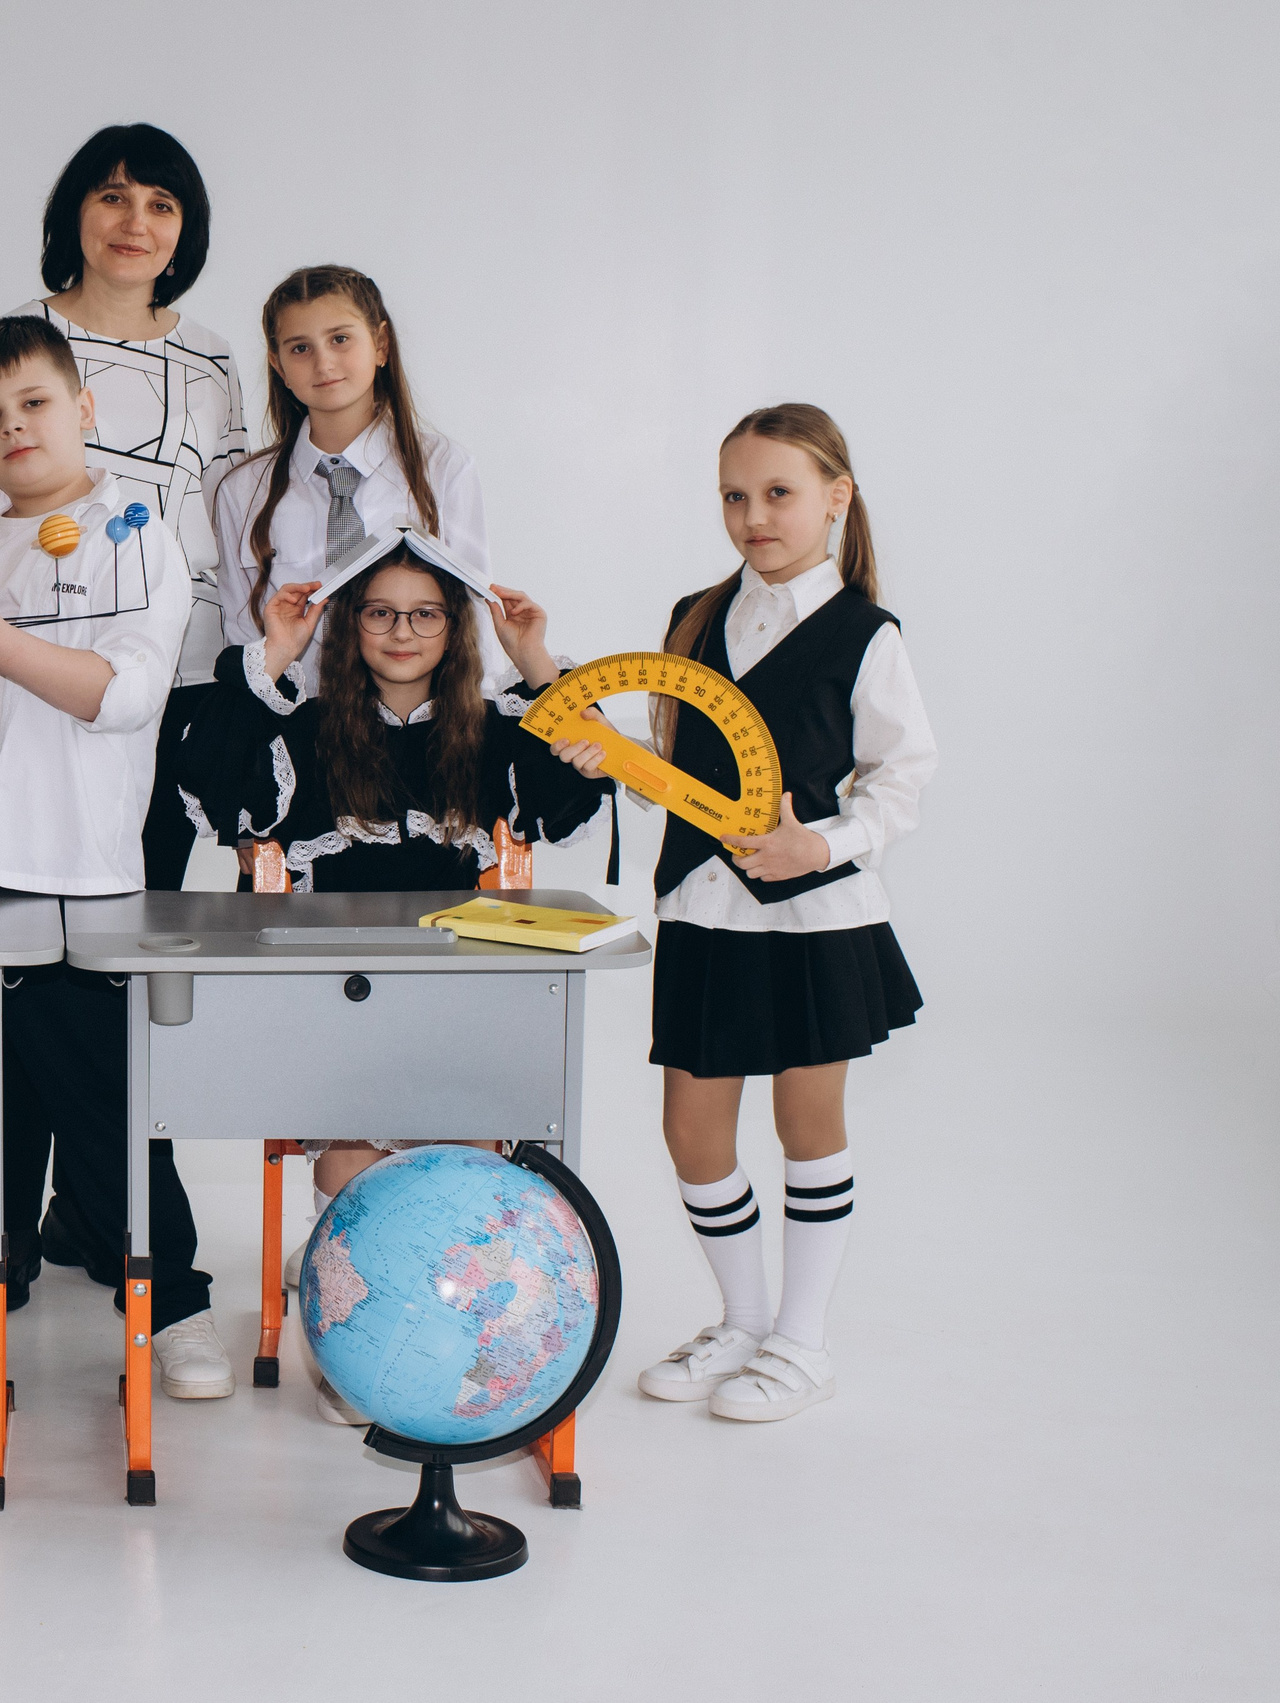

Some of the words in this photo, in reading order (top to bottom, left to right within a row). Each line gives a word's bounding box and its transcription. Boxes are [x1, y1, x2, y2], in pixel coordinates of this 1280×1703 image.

[61, 583, 87, 596] EXPLORE
[660, 670, 667, 678] 70
[619, 679, 628, 687] 130
[679, 675, 687, 683] 80
[580, 684, 588, 693] 30
[600, 684, 610, 692] 140
[675, 684, 685, 692] 100
[694, 686, 706, 697] 90
[583, 691, 593, 700] 150
[714, 695, 724, 705] 100
[563, 696, 571, 705] 20
[708, 703, 717, 711] 80
[723, 716, 730, 725] 70
[732, 732, 740, 741] 60
[740, 727, 749, 737] 120
[741, 749, 748, 758] 50
[747, 788, 754, 796] 30
[744, 807, 752, 815] 20
